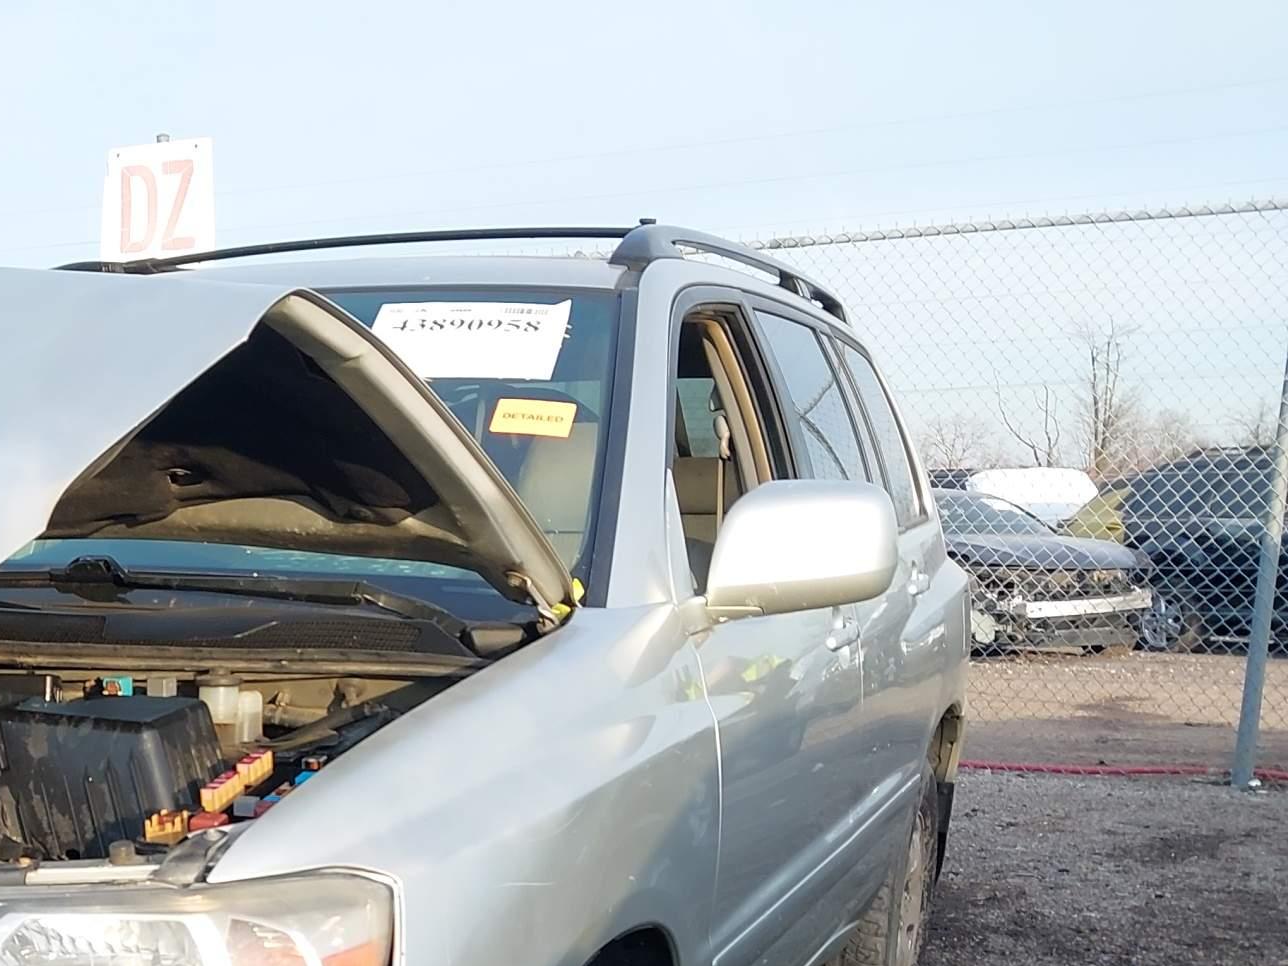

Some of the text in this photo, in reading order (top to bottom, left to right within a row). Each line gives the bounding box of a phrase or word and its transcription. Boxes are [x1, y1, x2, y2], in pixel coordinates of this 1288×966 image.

[120, 159, 195, 254] DZ
[392, 318, 541, 332] 43890958
[502, 412, 565, 423] DETAILED
